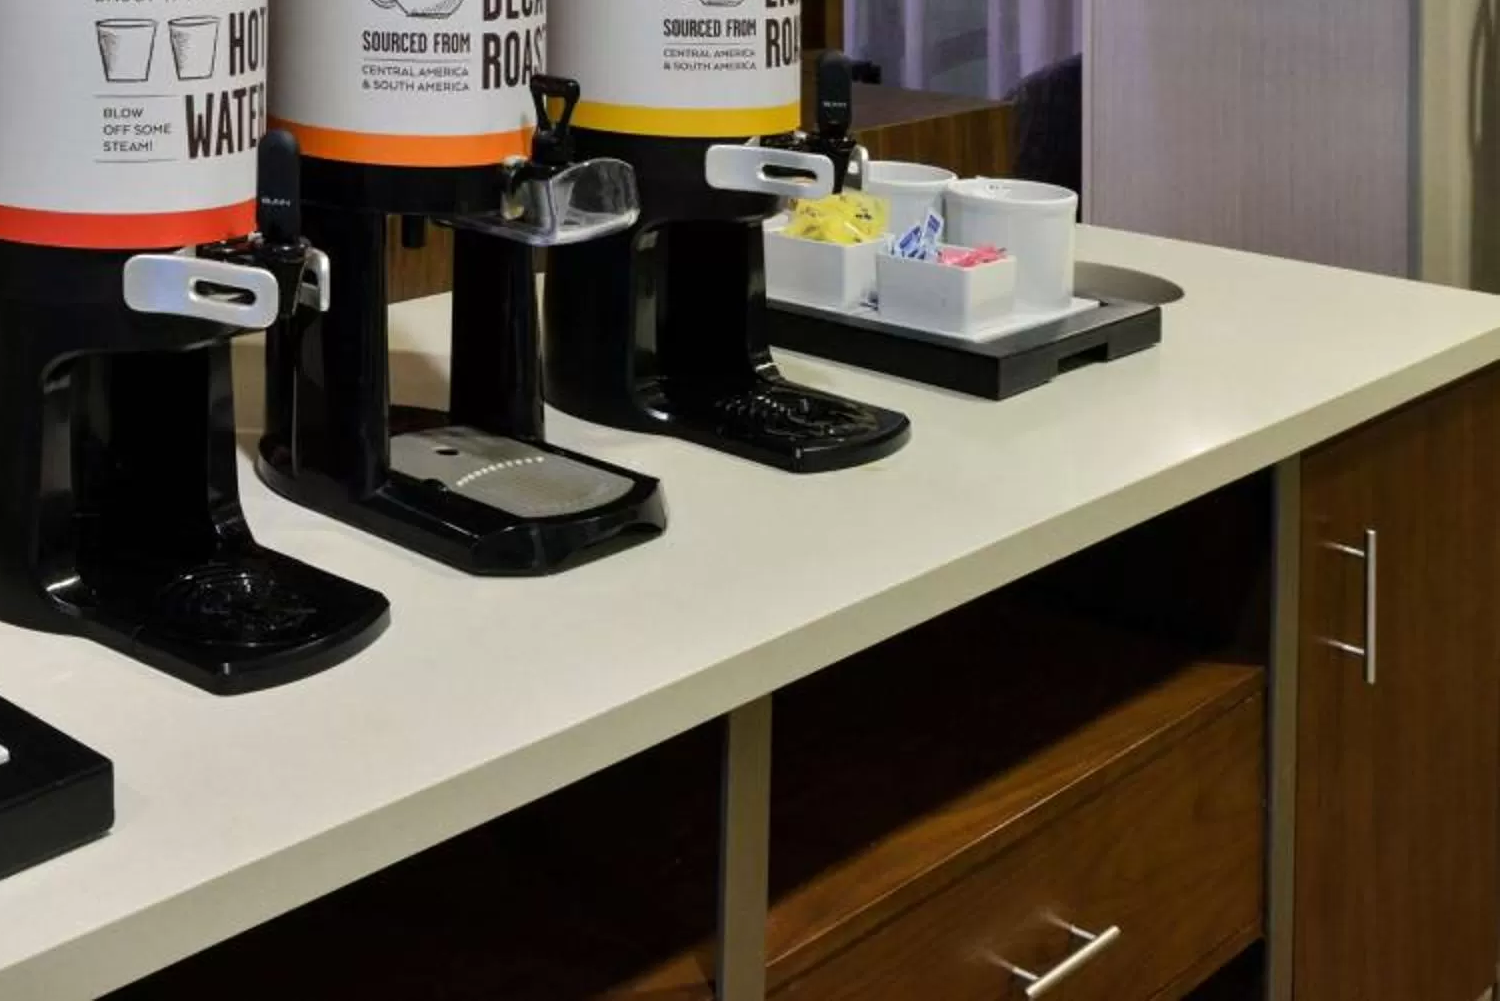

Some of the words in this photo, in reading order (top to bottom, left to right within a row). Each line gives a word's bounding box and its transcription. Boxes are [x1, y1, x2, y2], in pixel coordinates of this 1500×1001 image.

[663, 18, 721, 38] SOURCED
[726, 19, 757, 38] FROM
[362, 30, 428, 54] SOURCED
[434, 32, 471, 54] FROM
[482, 23, 547, 90] ROAS
[663, 49, 711, 58] CENTRAL
[713, 49, 756, 58] AMERICA
[362, 65, 414, 77] CENTRAL
[419, 65, 469, 78] AMERICA
[673, 61, 711, 71] SOUTH
[713, 62, 757, 71] AMERICA
[362, 81, 371, 90] &
[374, 81, 415, 91] SOUTH
[417, 81, 470, 92] AMERICA
[103, 107, 144, 118] BLOW
[103, 124, 131, 136] OFF
[133, 123, 172, 136] SOME
[103, 140, 153, 152] STEAM!
